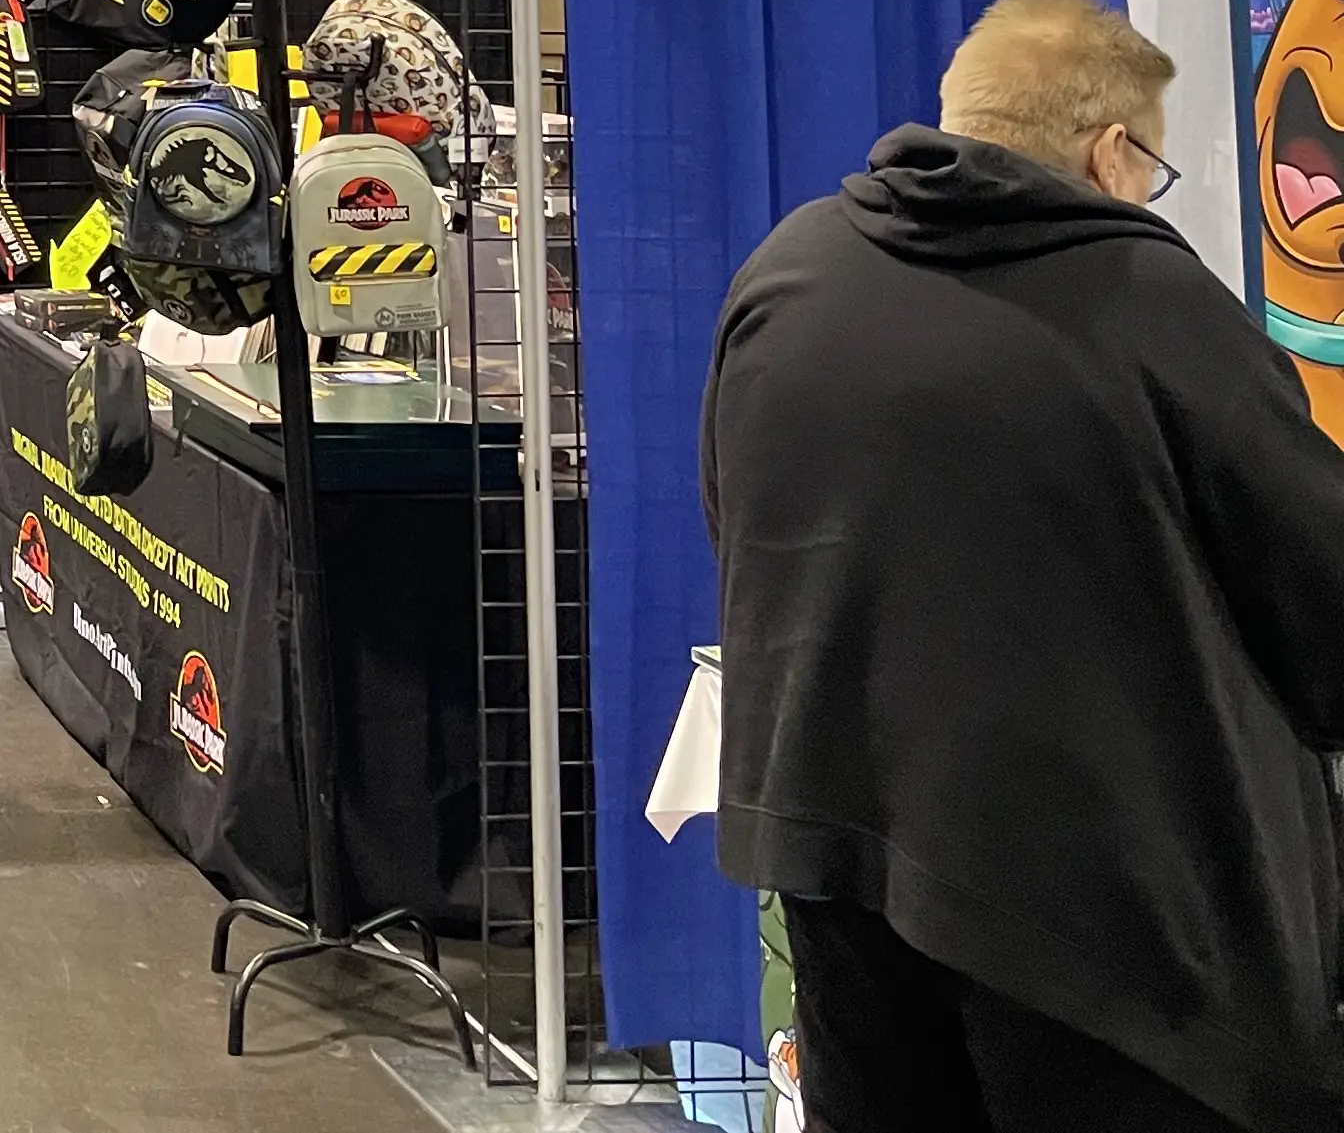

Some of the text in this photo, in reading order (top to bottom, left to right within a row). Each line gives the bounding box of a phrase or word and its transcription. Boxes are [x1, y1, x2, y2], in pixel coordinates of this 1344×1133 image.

[329, 205, 410, 223] JURASSIC PARK
[43, 494, 71, 535] FROM
[70, 515, 117, 575] UNIVERSAL
[153, 589, 182, 628] 1994
[175, 552, 197, 590] ART
[196, 564, 230, 613] PRINTS
